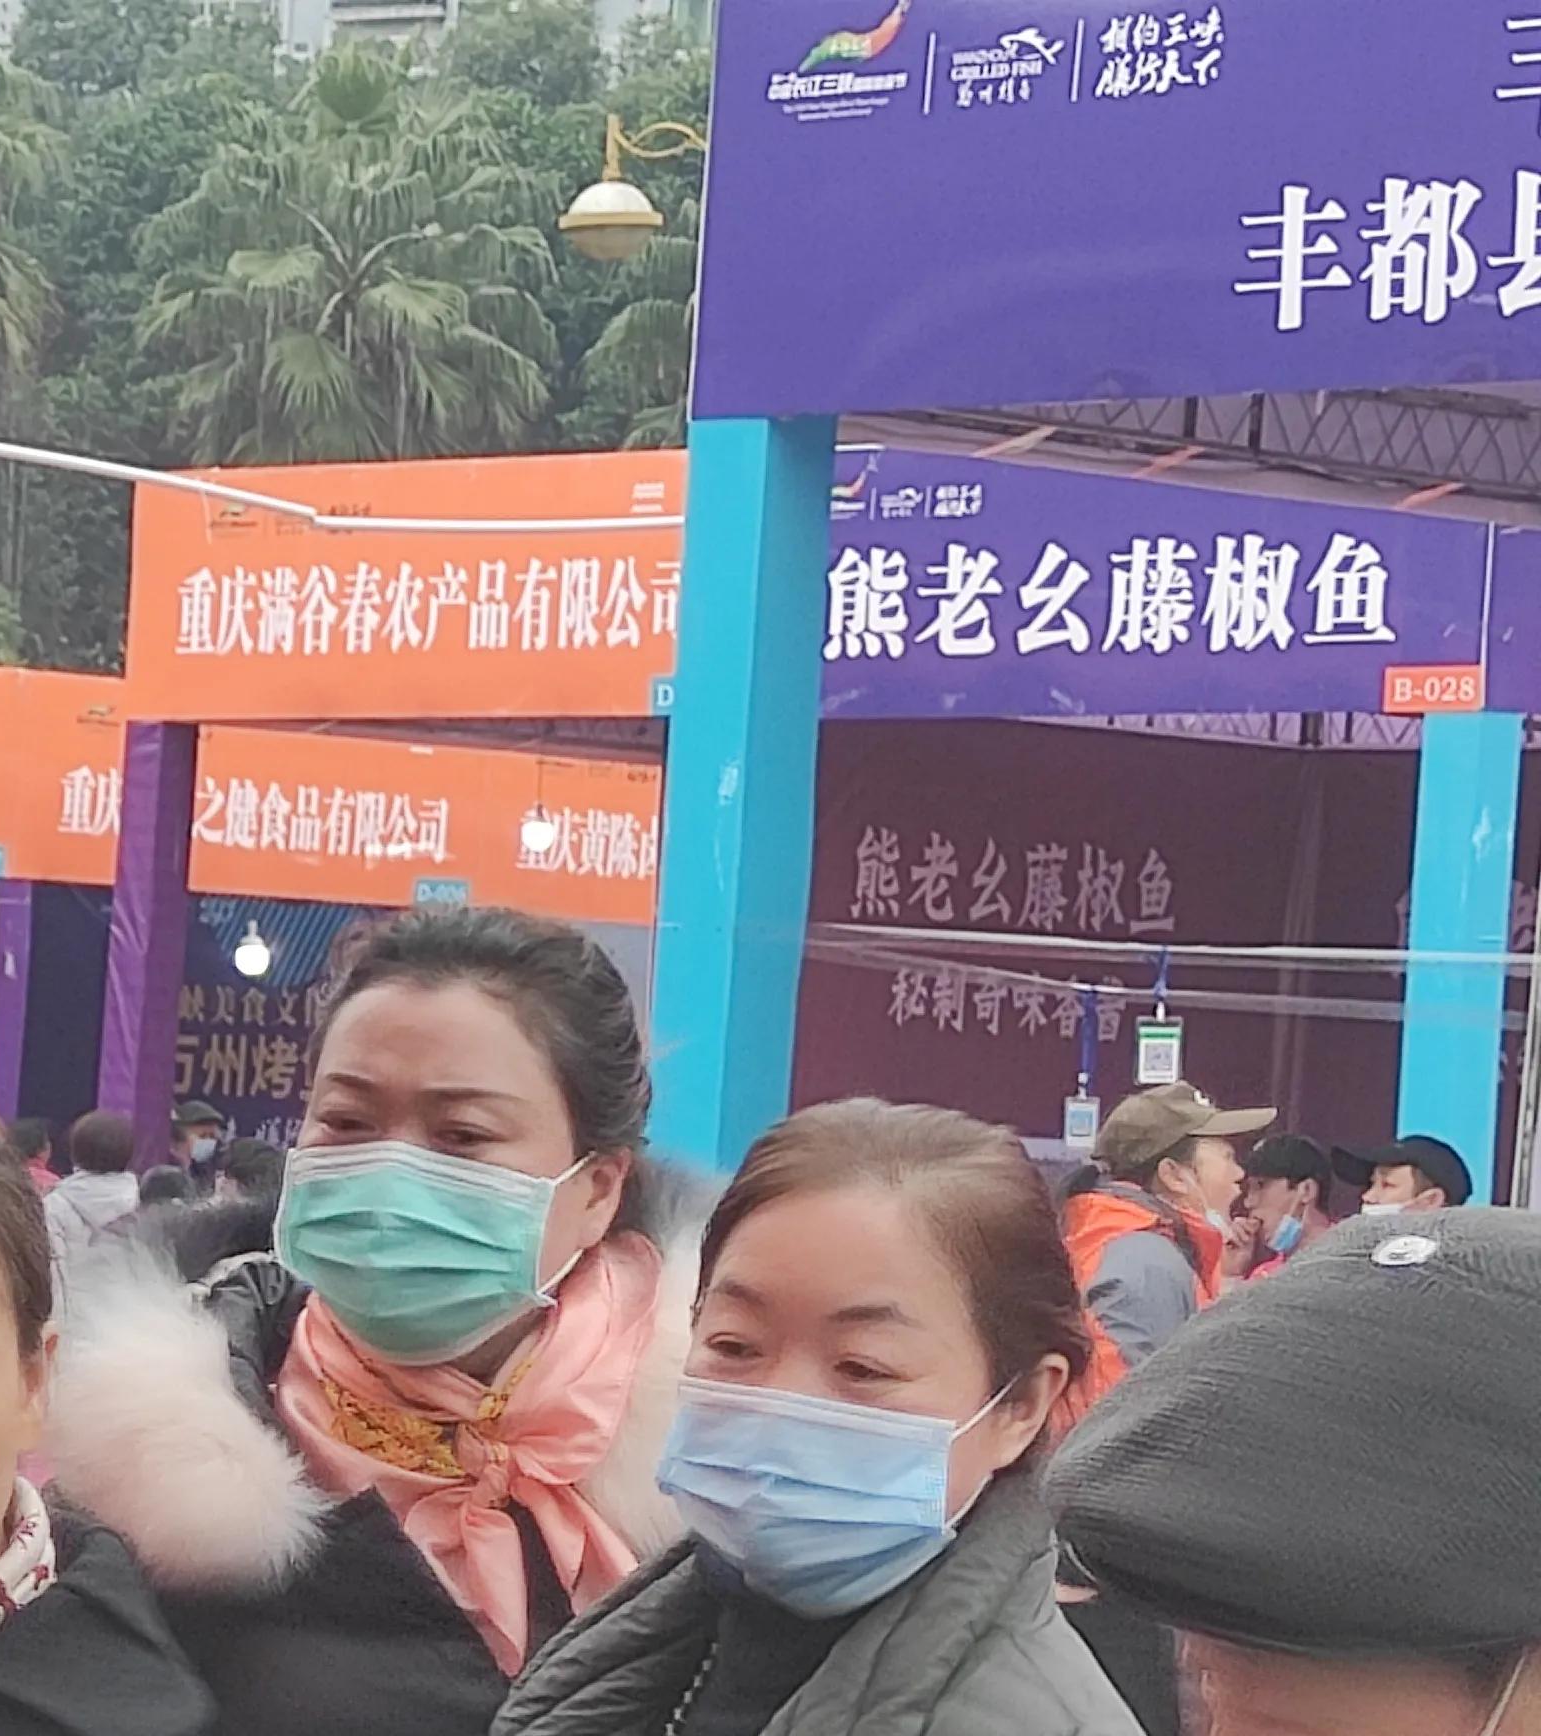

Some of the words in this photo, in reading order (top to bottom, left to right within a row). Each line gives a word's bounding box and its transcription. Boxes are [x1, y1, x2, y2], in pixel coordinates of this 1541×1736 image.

[175, 555, 681, 655] 重庆满谷春农产品有限公司
[824, 531, 1397, 661] 熊老幺藤椒鱼
[1393, 675, 1476, 703] B-028
[191, 777, 450, 864] 之健食品有限公司
[849, 825, 1175, 934] 熊老幺藤椒鱼
[174, 1033, 314, 1100] 万州烤
